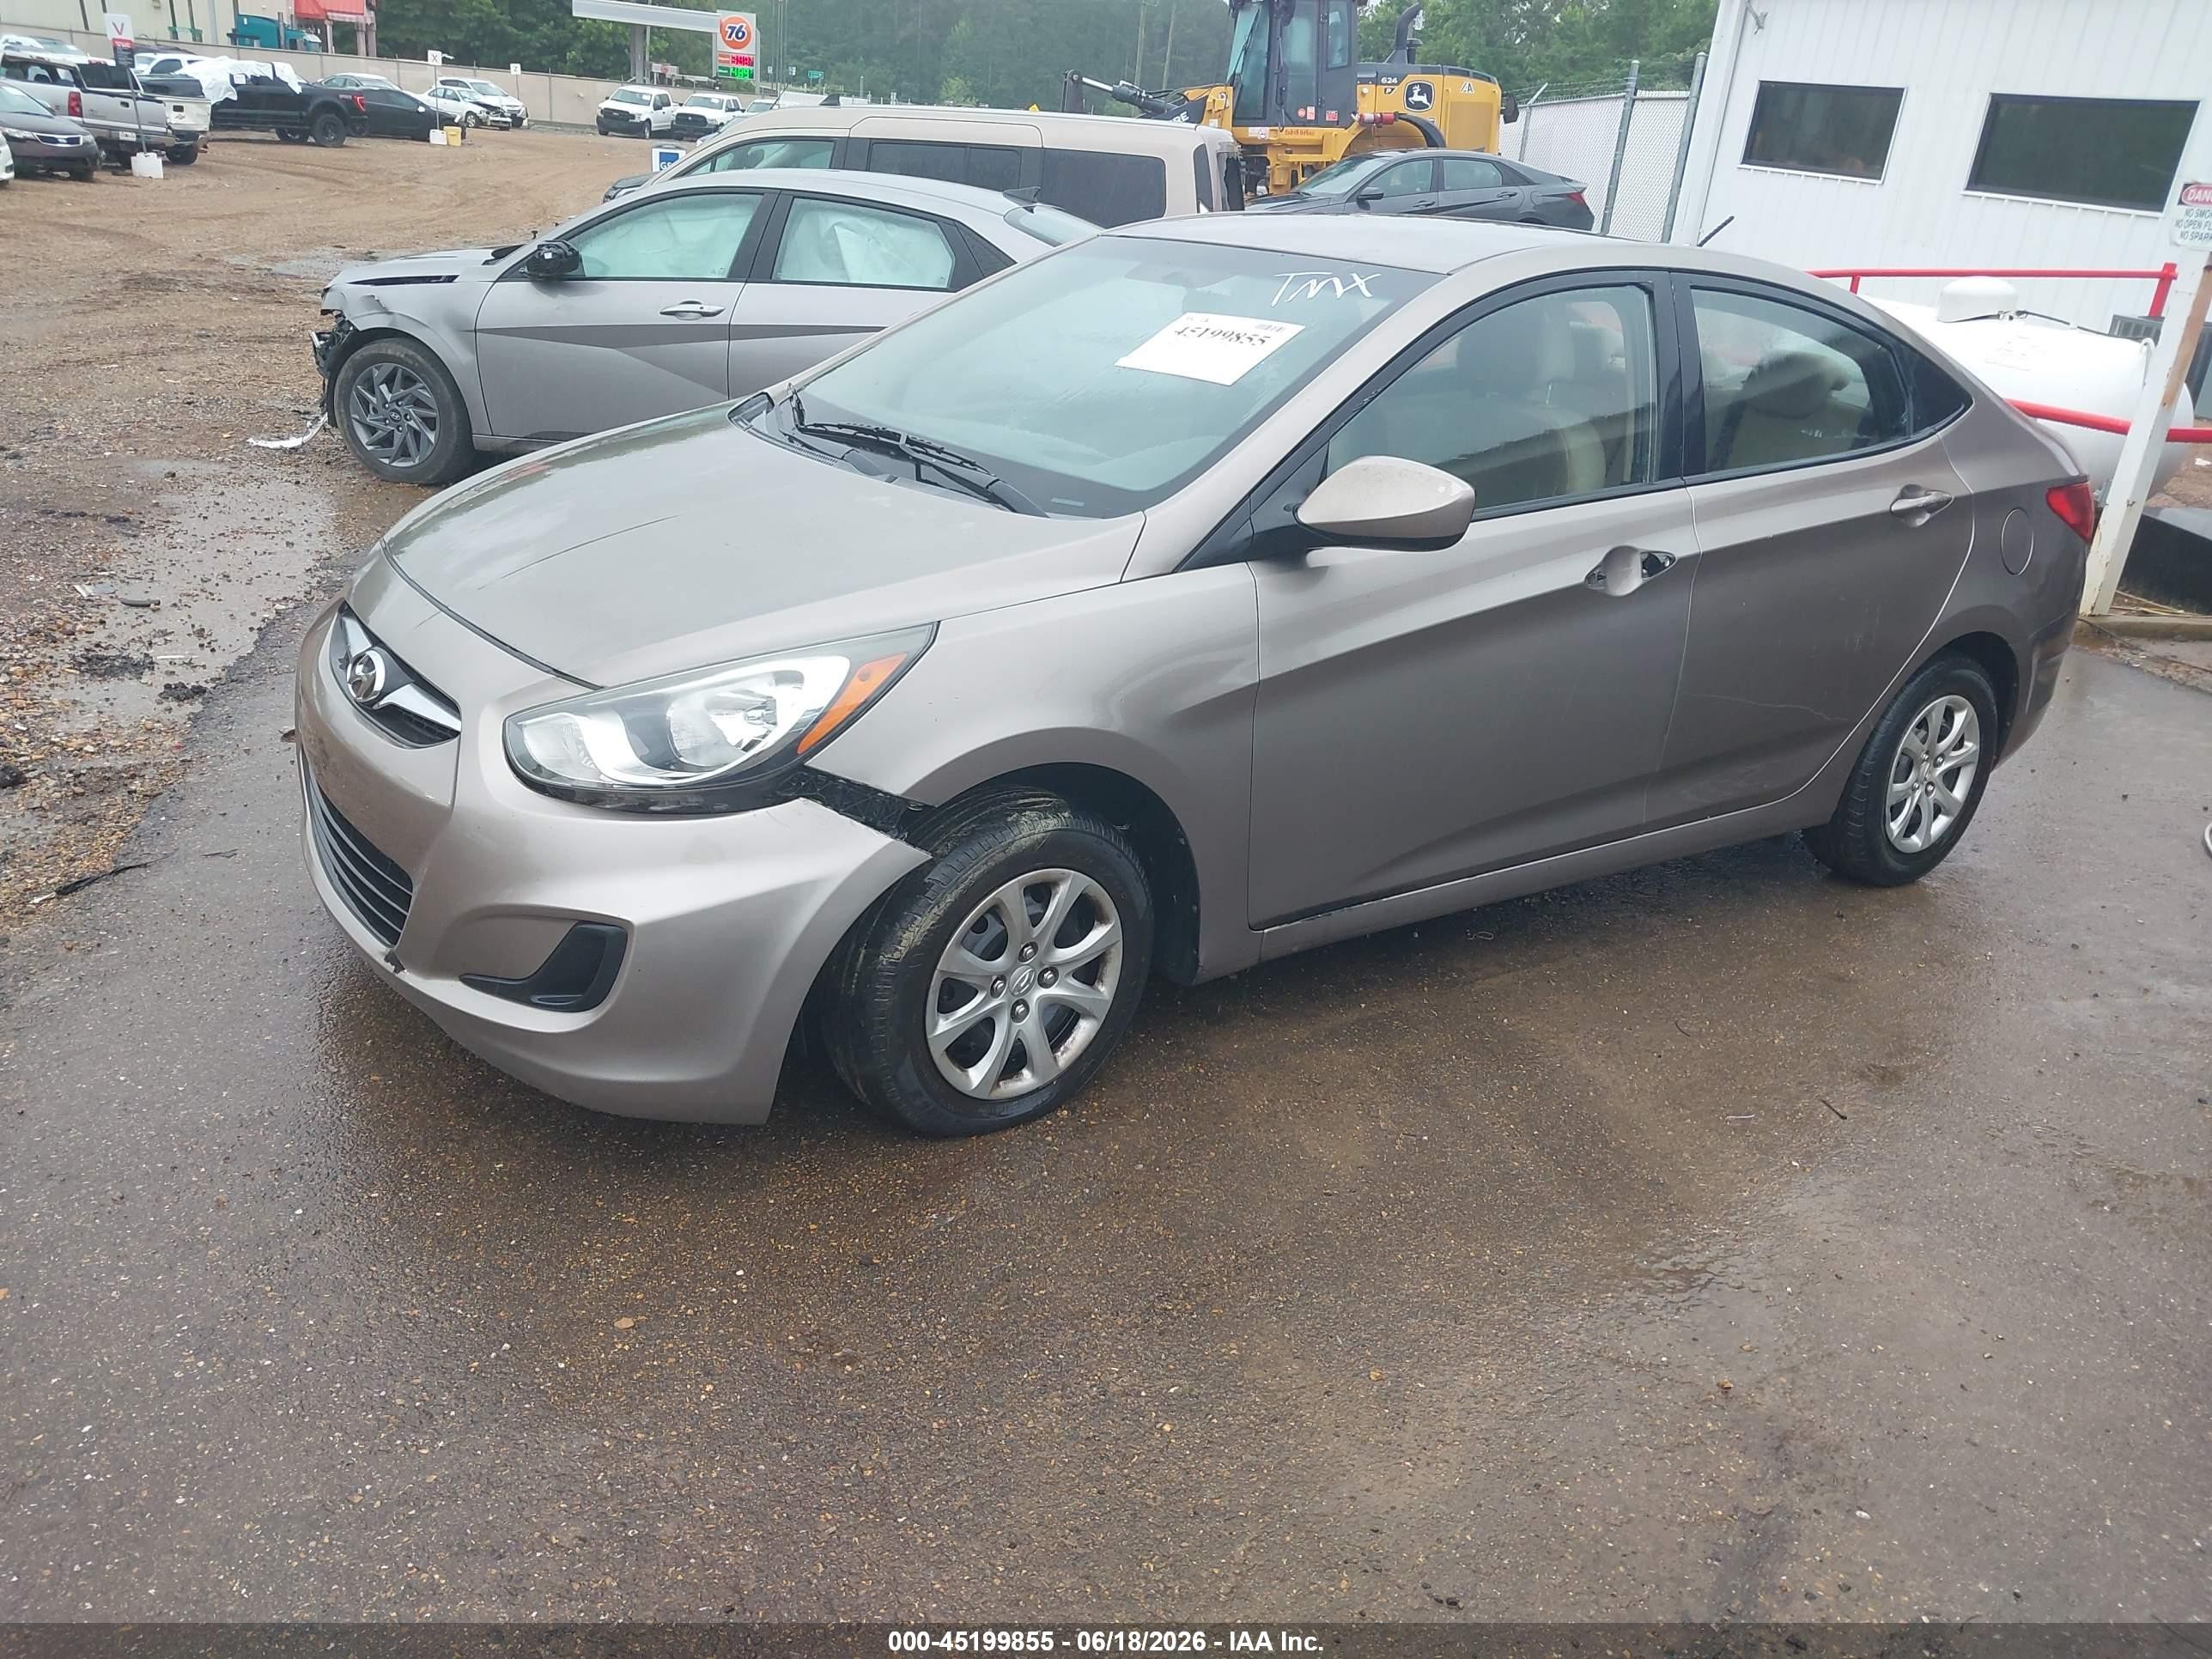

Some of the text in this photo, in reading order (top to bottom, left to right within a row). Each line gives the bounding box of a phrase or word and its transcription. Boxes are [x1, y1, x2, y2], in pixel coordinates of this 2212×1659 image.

[112, 21, 125, 35] V
[726, 24, 746, 41] 76
[432, 54, 438, 63] X
[2185, 208, 2212, 220] NO SMO
[1173, 325, 1272, 346] 45199855
